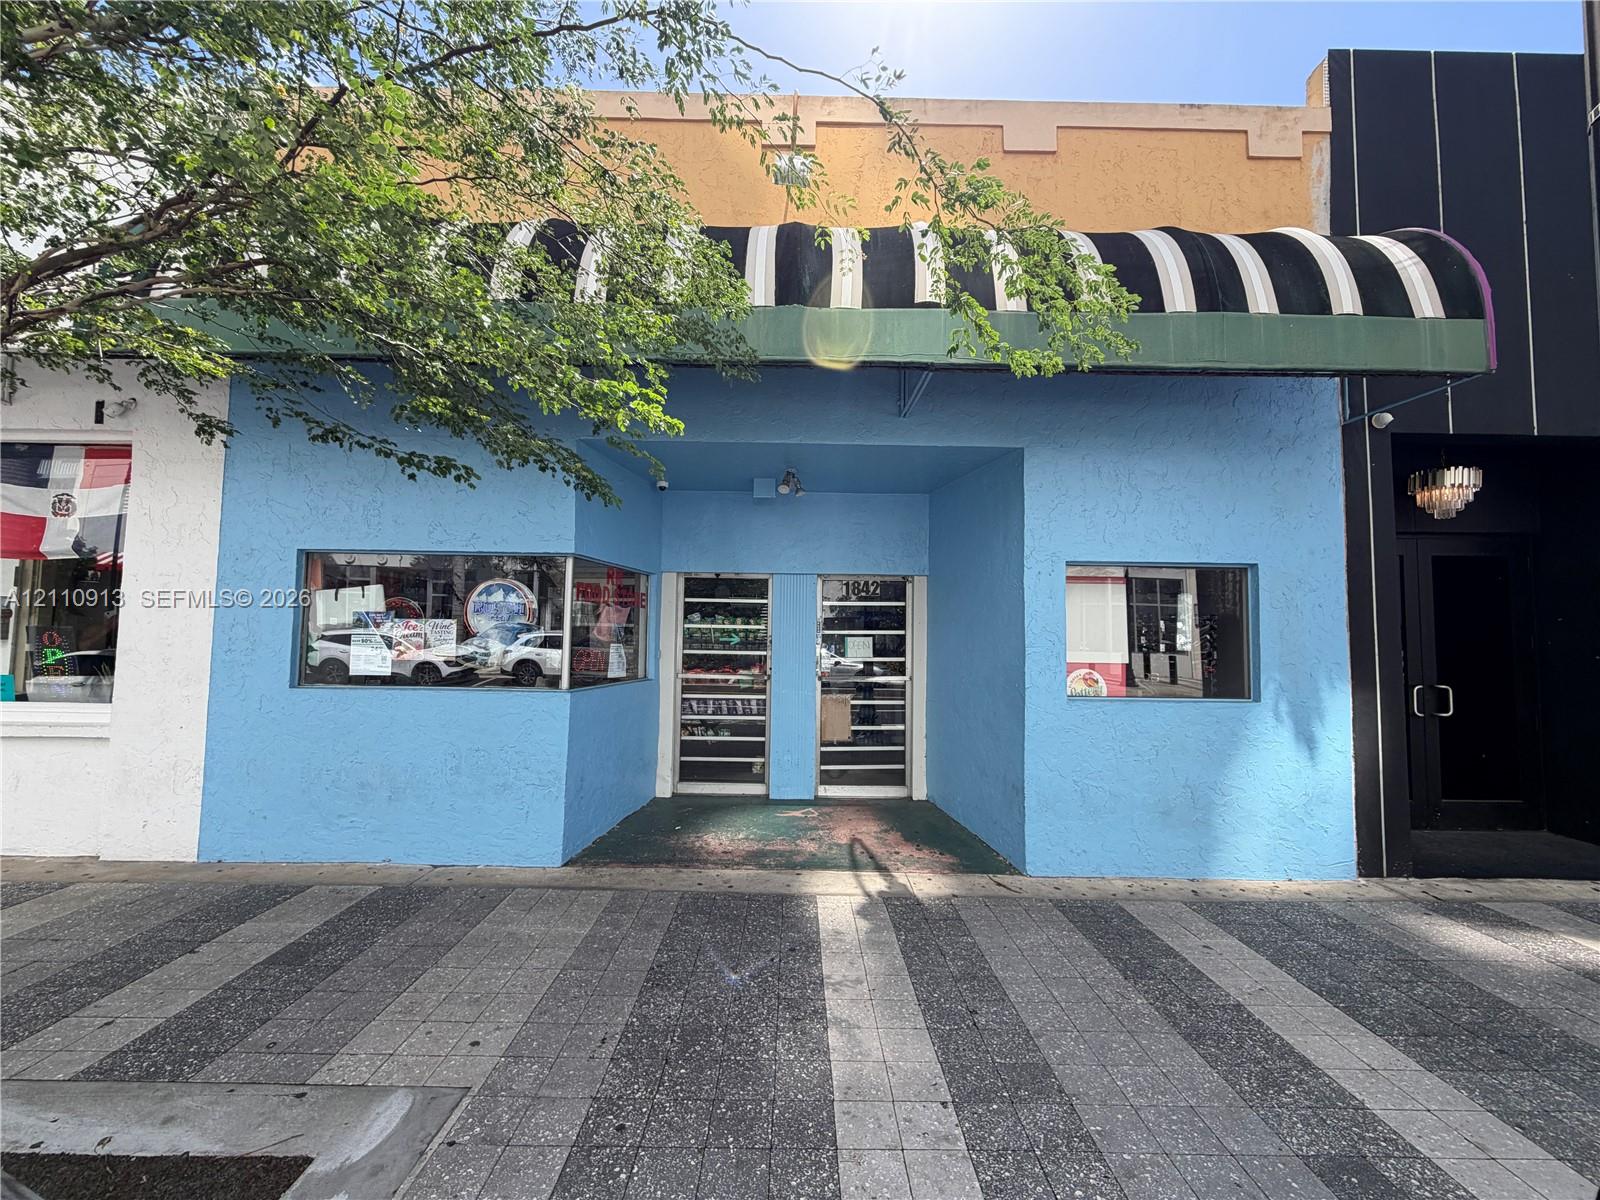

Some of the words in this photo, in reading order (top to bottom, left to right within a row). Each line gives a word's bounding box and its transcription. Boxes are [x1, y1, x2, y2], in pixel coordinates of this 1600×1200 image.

[843, 580, 880, 597] 1842
[402, 620, 419, 631] Ice
[428, 621, 454, 630] Wine
